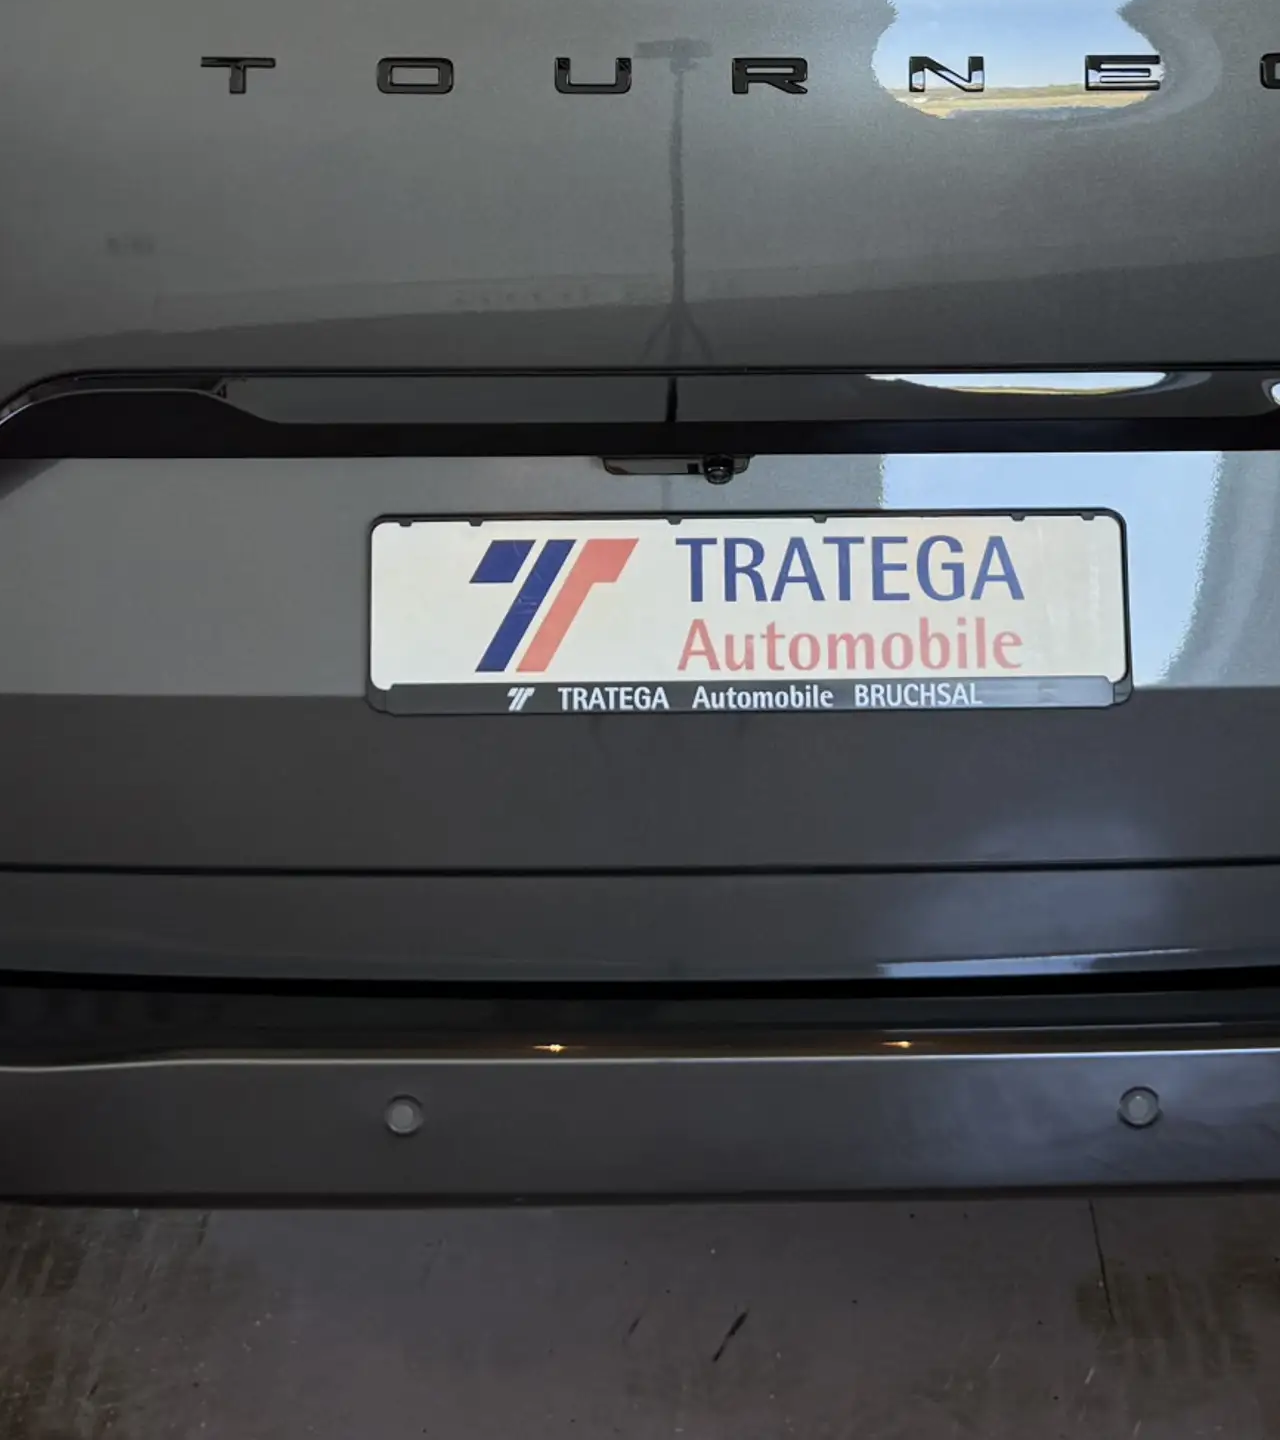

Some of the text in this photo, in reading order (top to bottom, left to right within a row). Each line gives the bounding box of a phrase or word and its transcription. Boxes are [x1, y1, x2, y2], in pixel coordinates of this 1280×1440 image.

[675, 535, 1025, 603] TRATEGA
[677, 617, 1024, 672] Automobile
[557, 682, 983, 712] TRATEGA Automobile BRUCHSAL
